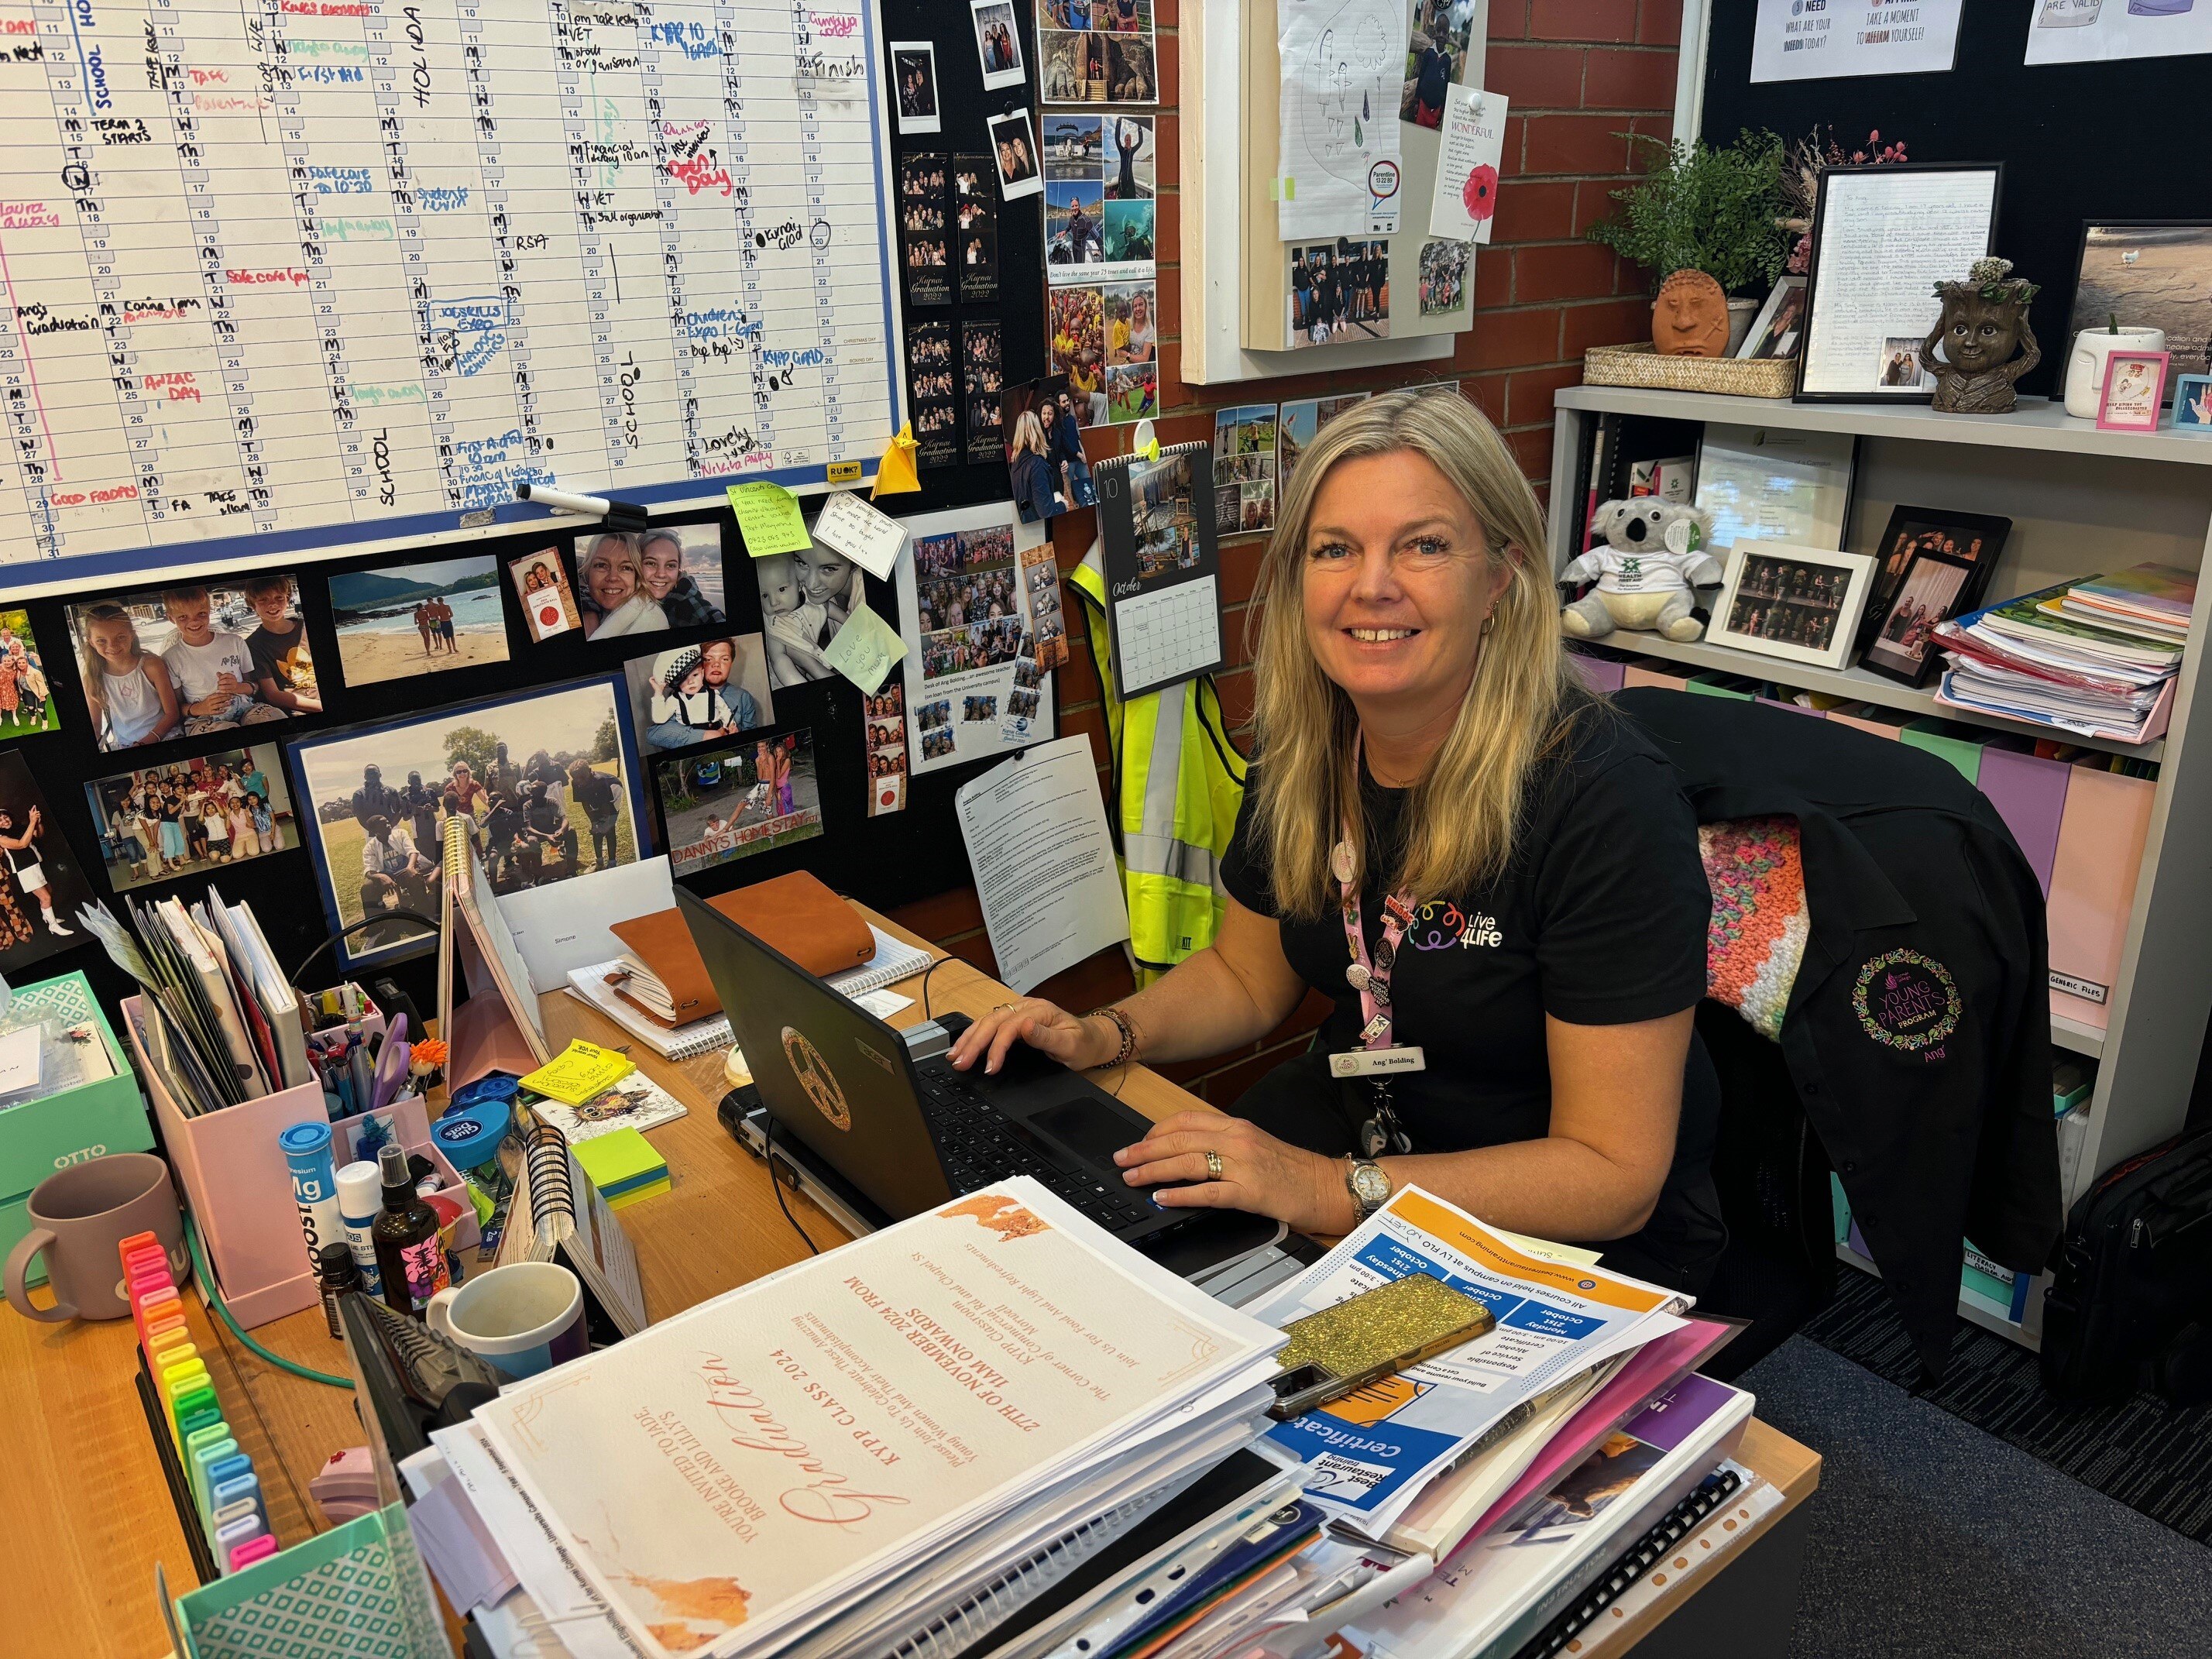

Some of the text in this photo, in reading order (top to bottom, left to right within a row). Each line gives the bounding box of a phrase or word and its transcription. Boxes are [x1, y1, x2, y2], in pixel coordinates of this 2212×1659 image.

[1805, 0, 1826, 12] NEED
[2046, 1, 2066, 11] ARE
[1785, 19, 1831, 33] WHAT ARE YOUR
[1867, 9, 1920, 26] TAKE A MOMENT
[569, 26, 592, 42] VET
[1856, 27, 1925, 45] TO AFFIRM YOURSELF!
[1784, 36, 1827, 52] NEEDS TODAY?
[812, 51, 864, 77] Finish
[88, 44, 112, 109] SCHOOL
[91, 119, 146, 131] TERM 2
[1451, 122, 1494, 139] WONDERFUL
[102, 132, 151, 145] STARTS
[668, 154, 709, 183] Open
[686, 168, 732, 197] Day
[593, 191, 615, 205] VET
[87, 214, 100, 222] 18
[516, 234, 549, 250] RSA
[915, 275, 943, 286] Kurnai
[960, 281, 998, 291] Graduation
[965, 272, 992, 284] Kurnai
[911, 283, 950, 294] Graduation
[923, 292, 943, 301] 2022
[970, 290, 990, 299] 2022
[620, 352, 638, 449] SCHOOL
[373, 428, 394, 507] SCHOOL
[51, 489, 86, 506] GOOD
[1103, 478, 1118, 499] 10
[1112, 577, 1142, 598] October
[839, 634, 863, 663] Love
[856, 647, 871, 669] you
[961, 682, 983, 692] University
[735, 810, 808, 846] HOMESTAY
[1385, 896, 1413, 924] NAIDOC
[555, 935, 576, 944] Simone
[1879, 981, 1931, 1009] YOUNG
[2050, 976, 2100, 998] GENERIC FILES
[1878, 992, 1946, 1027] PARENTS
[1898, 1009, 1937, 1029] PROGRAM
[1389, 1057, 1415, 1066] Bolding
[444, 1121, 472, 1136] Dots
[452, 1125, 479, 1139] Glue
[53, 1144, 107, 1170] OTTO
[1389, 1243, 1428, 1269] October
[1458, 1231, 1575, 1283] www.bestrestauranttraining.com
[1421, 1241, 1588, 1310] All courses held on campus at LV FLO
[1462, 1285, 1503, 1301] October
[963, 1242, 1142, 1370] Join Us For Food And Light Refreshments
[994, 1304, 1041, 1336] Morwell
[1540, 1308, 1584, 1324] October
[1544, 1318, 1566, 1328] 21st
[911, 1250, 1113, 1403] The Corner of Commercial Rd and Chapel St
[951, 1300, 1036, 1366] KYPP Classroom
[1524, 1321, 1568, 1334] Monday
[843, 1275, 1042, 1433] 27TH OF NOVEMBER 2024 FROM
[904, 1307, 1010, 1389] 11AM ONWARDS
[1494, 1343, 1530, 1354] Alcohol
[1466, 1356, 1519, 1370] Responsible
[791, 1315, 967, 1468] Please Join Us To Celebrate These Amazing
[804, 1311, 979, 1463] Young Women And Their Accomplishments
[769, 1348, 902, 1466] KYPP CLASS 2024
[689, 1350, 912, 1534] Graduation
[658, 1410, 768, 1521] BROOKE AND LILLY'S
[1326, 1454, 1360, 1466] training
[634, 1406, 759, 1544] YOU'RE INVITED TO JADE,
[1317, 1458, 1387, 1482] Restaurant
[1347, 1475, 1379, 1489] Best
